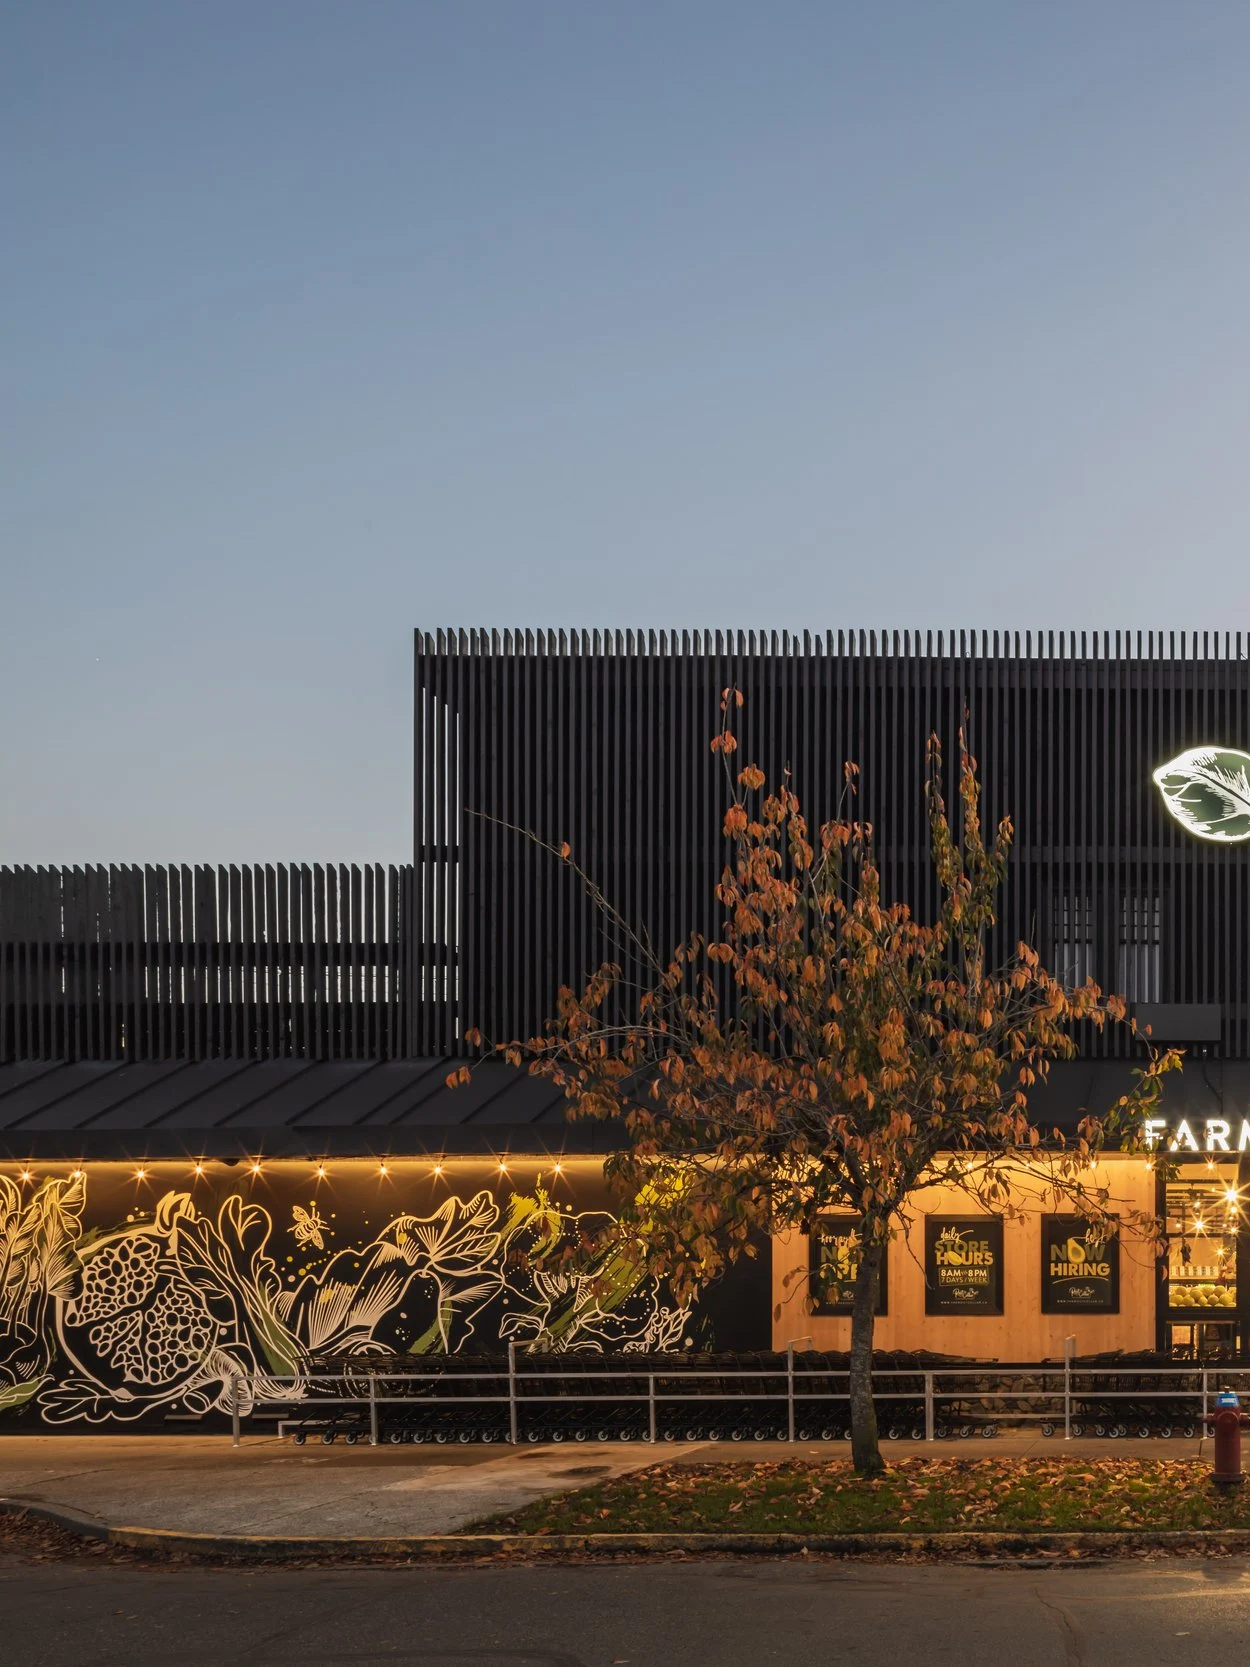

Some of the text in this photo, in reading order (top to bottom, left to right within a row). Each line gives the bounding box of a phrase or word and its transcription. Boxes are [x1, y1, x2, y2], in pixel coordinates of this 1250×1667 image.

[940, 1226, 974, 1244] daily
[935, 1240, 989, 1253] STORE
[936, 1251, 994, 1265] HOURS
[1050, 1263, 1110, 1276] HIRING
